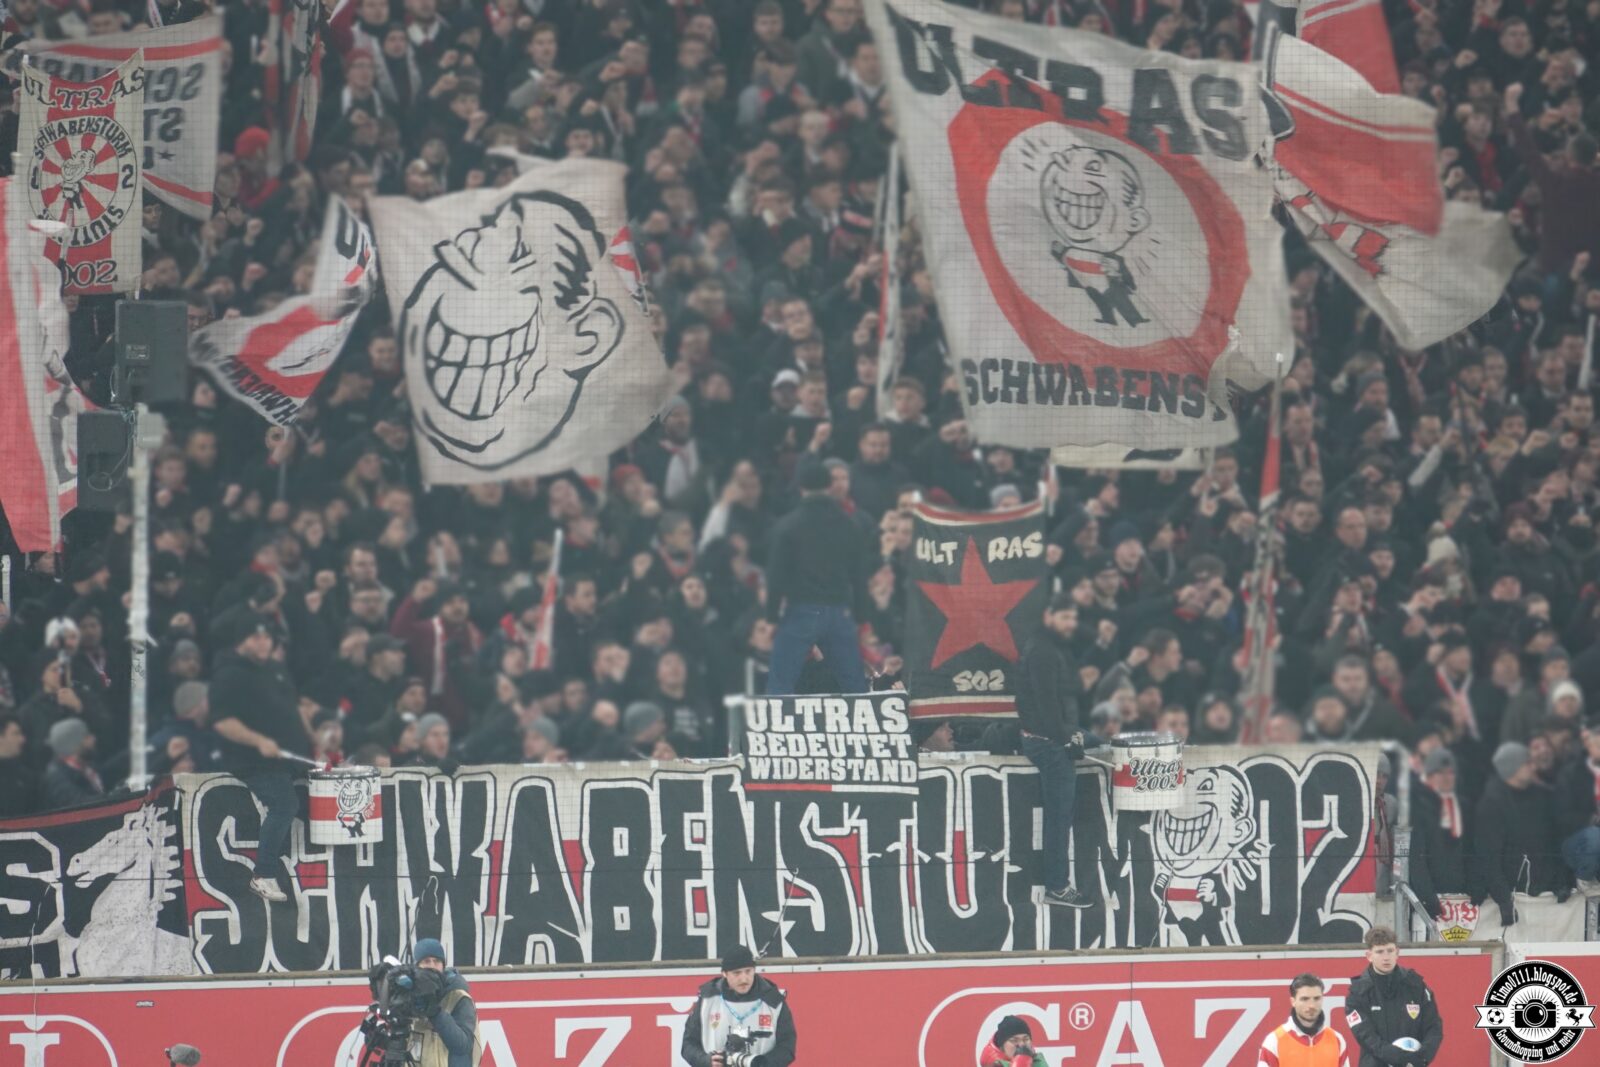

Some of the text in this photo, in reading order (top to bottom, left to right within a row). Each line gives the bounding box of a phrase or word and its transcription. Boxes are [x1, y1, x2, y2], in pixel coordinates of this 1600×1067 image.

[24, 66, 144, 109] ULTRAS
[745, 697, 910, 734] ULTRAS
[746, 731, 912, 759] BEDEUTET
[748, 757, 918, 783] WIDERSTAND
[190, 763, 1160, 974] SCHWABENSTURM
[1225, 751, 1374, 947] 02
